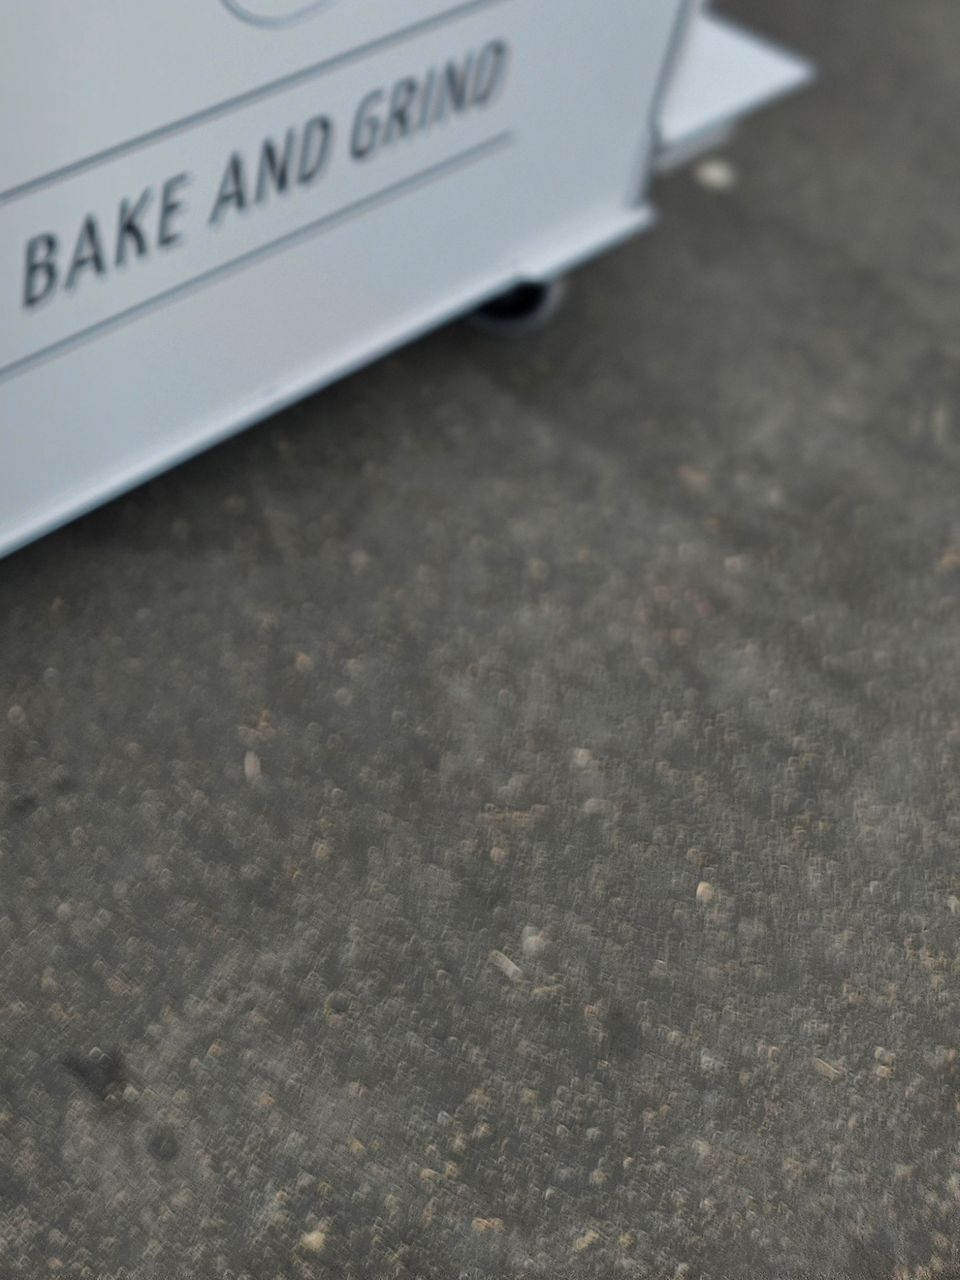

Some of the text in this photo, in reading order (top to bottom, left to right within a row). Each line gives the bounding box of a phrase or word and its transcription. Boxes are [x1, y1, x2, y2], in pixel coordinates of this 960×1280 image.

[22, 38, 509, 310] BAKE AND GRIND
